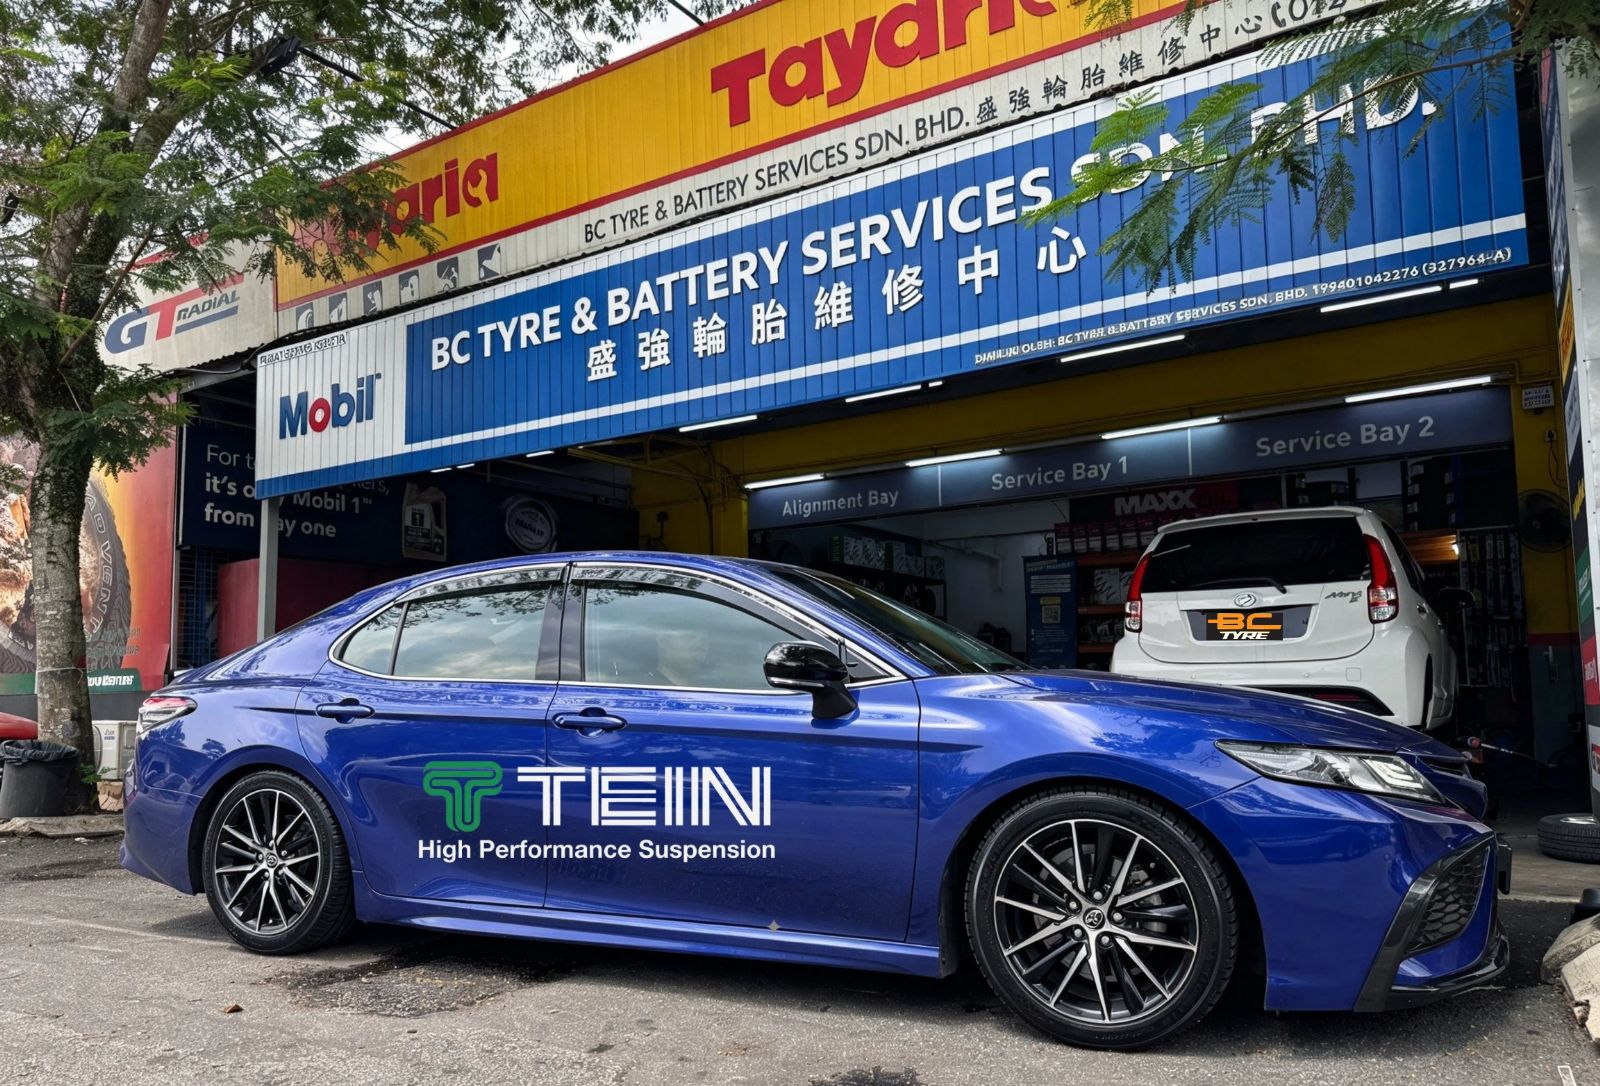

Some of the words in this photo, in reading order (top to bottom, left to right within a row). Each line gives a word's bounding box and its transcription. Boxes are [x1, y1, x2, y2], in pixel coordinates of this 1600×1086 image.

[976, 14, 1263, 126] 盛強輪胎維修中心
[585, 218, 607, 243] BC
[610, 204, 650, 235] TYRE
[655, 200, 668, 221] &
[674, 173, 749, 216] BATTERY
[755, 141, 849, 192] SERVICES
[855, 124, 910, 161] SDN.
[915, 105, 970, 142] BHD.
[431, 330, 471, 371] BC
[478, 304, 562, 358] TYRE
[571, 296, 598, 335] &
[607, 240, 789, 327] BATTERY
[801, 166, 1053, 276] SERVICES
[1312, 265, 1419, 296] 199401042276
[105, 272, 244, 354] GT
[176, 289, 240, 322] RADIAL
[586, 226, 1087, 382] 盛強輪胎維修中心
[279, 374, 374, 440] Mobil
[206, 443, 241, 468] For
[1255, 430, 1352, 457] Service
[1359, 422, 1411, 446] Bay
[1418, 415, 1435, 438] 2
[992, 467, 1065, 491] Service
[1072, 461, 1113, 482] Bay
[1118, 456, 1128, 474] 1
[204, 502, 255, 528] from
[278, 517, 296, 538] ay
[301, 521, 337, 538] one
[293, 491, 346, 513] Mobil
[782, 491, 863, 518] Alignment
[868, 489, 899, 508] Bay
